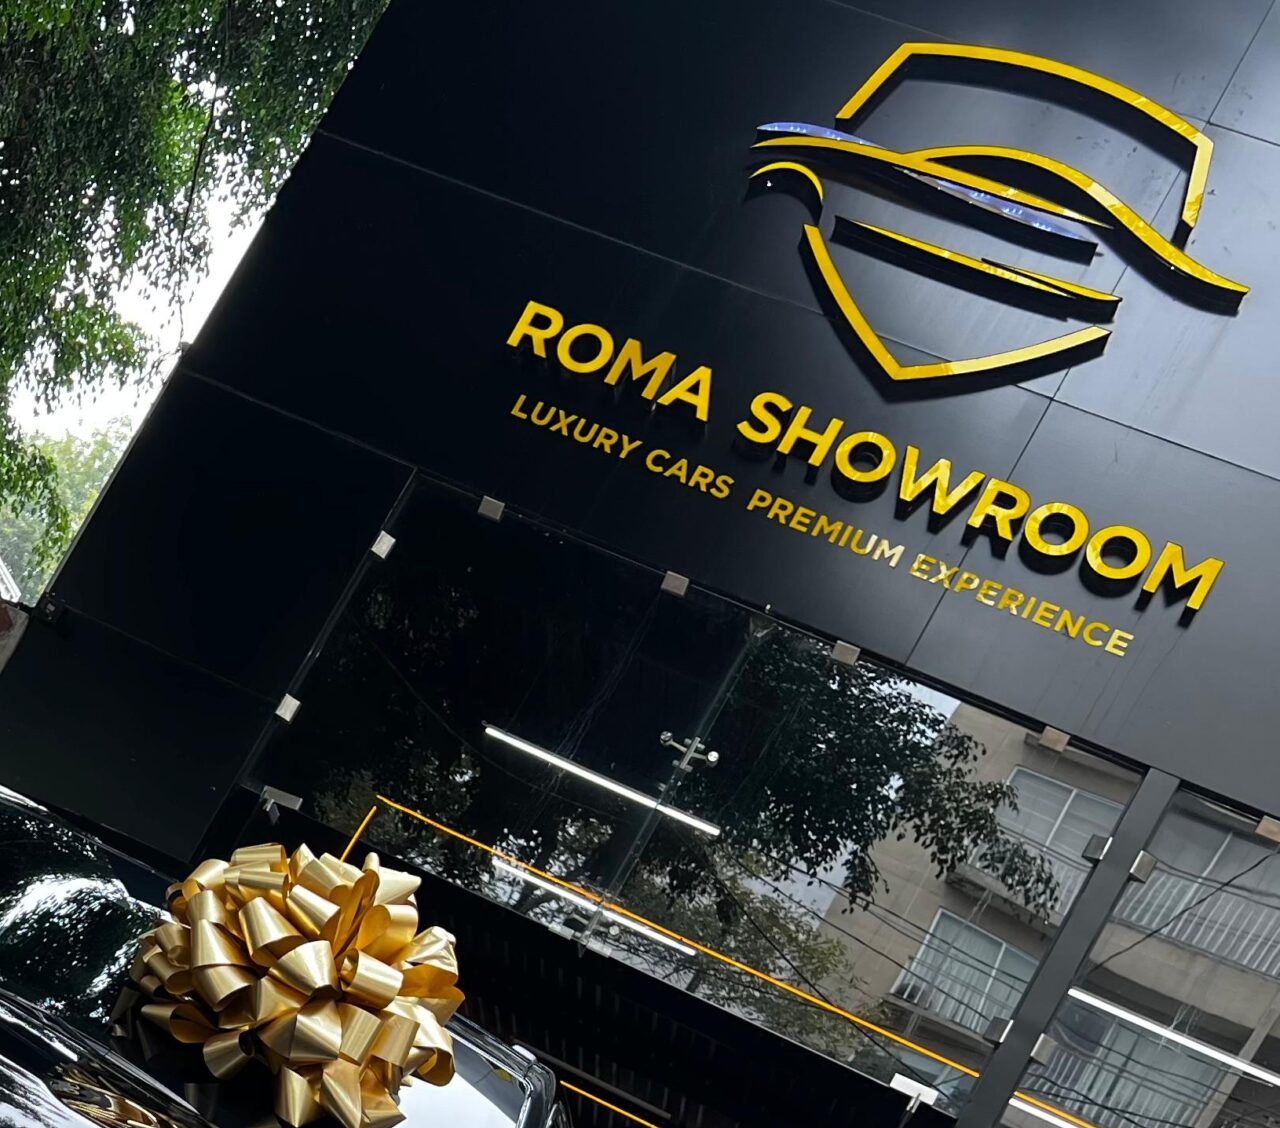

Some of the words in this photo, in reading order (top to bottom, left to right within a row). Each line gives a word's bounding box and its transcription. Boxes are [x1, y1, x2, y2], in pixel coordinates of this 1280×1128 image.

[506, 300, 712, 422] ROMA
[736, 391, 1226, 611] SHOWROOM
[510, 394, 644, 459] LUXURY
[645, 449, 736, 499] CARS
[746, 488, 906, 569] PREMIUM
[909, 553, 1136, 657] EXPERIENCE
